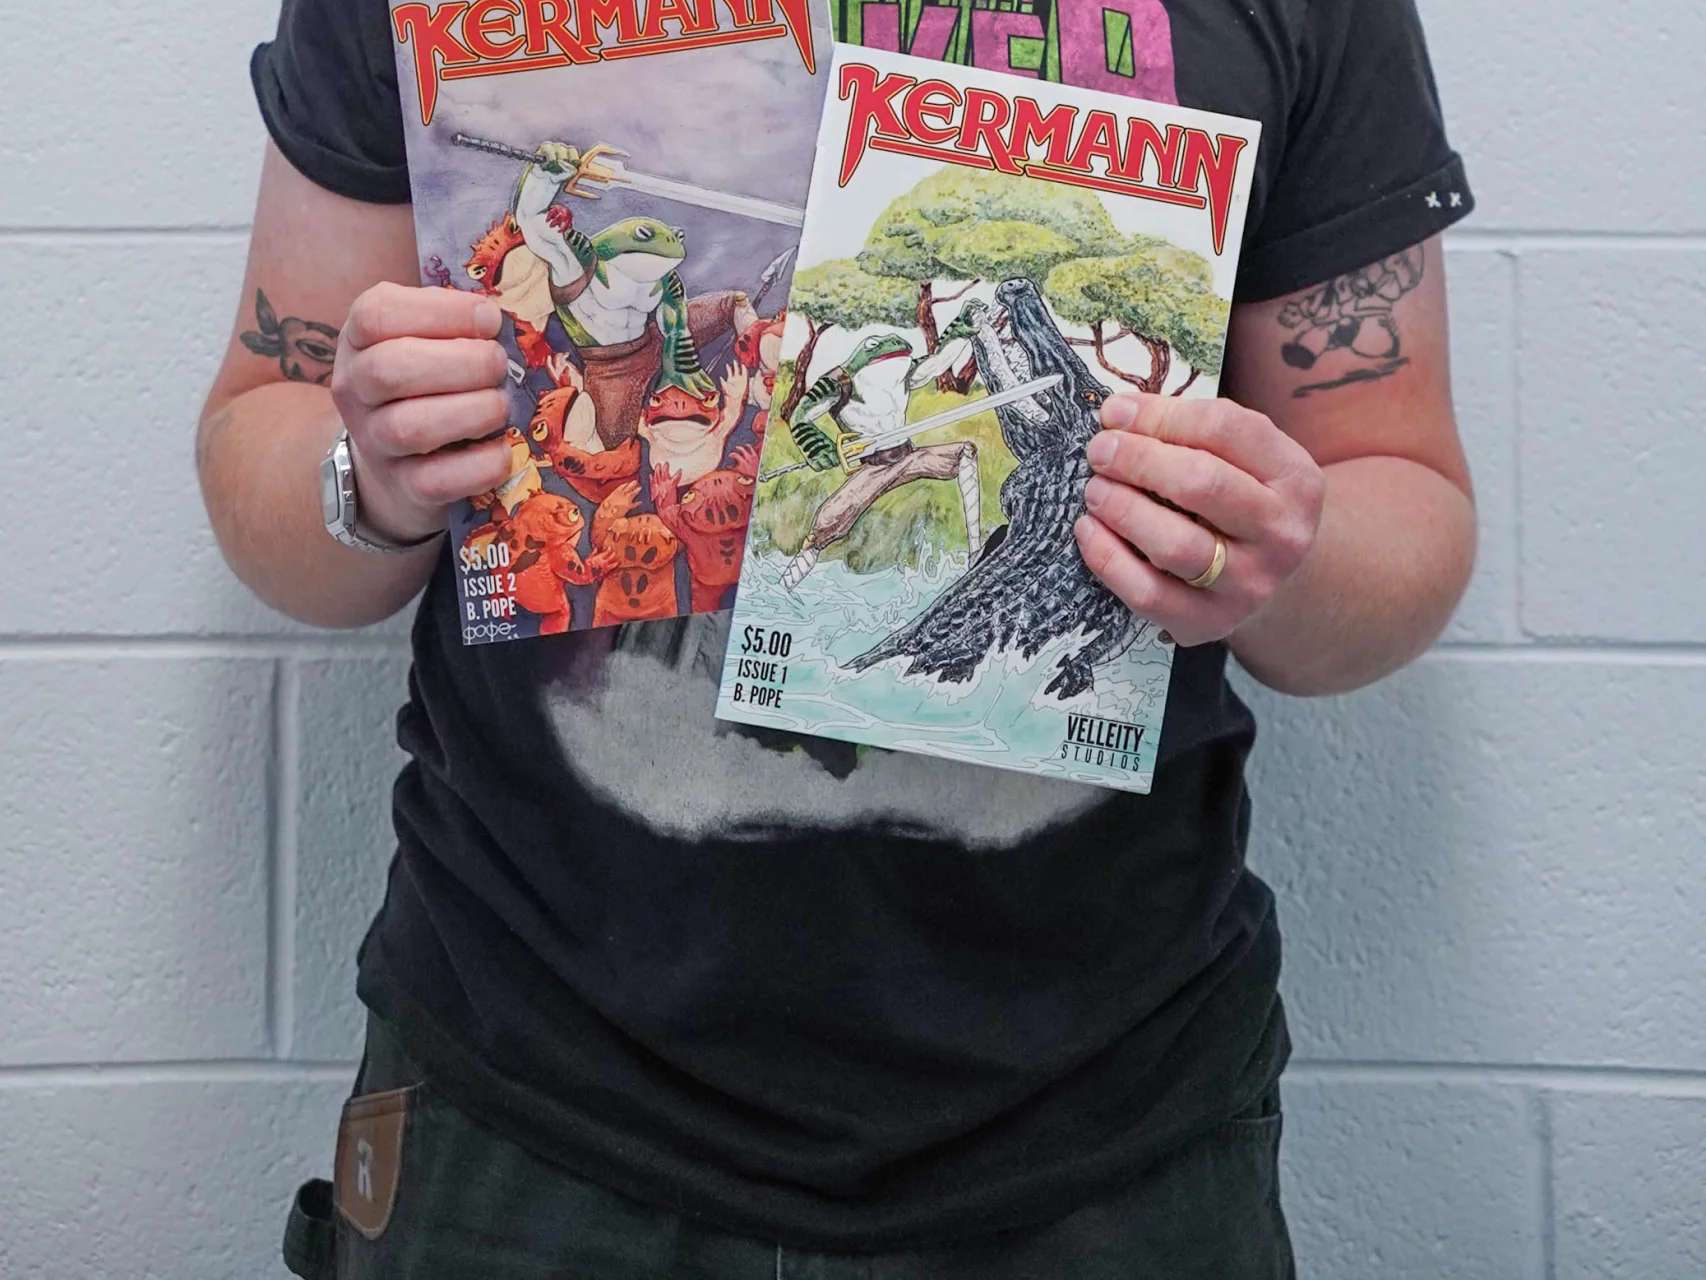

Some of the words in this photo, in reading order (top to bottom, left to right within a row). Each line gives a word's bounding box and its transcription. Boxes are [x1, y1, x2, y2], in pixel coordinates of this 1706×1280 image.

[839, 63, 1248, 256] KERMANN
[459, 542, 510, 574] $5.00
[463, 574, 503, 597] ISSUE
[507, 572, 517, 592] 2
[466, 601, 481, 620] B.
[482, 597, 517, 619] POPE
[741, 625, 792, 657] $5.00
[737, 658, 778, 683] ISSUE
[781, 665, 788, 684] 1
[733, 683, 746, 703] B.
[749, 686, 783, 708] POPE
[1067, 715, 1145, 752] VELLEITY
[1060, 745, 1141, 771] STUDIOS
